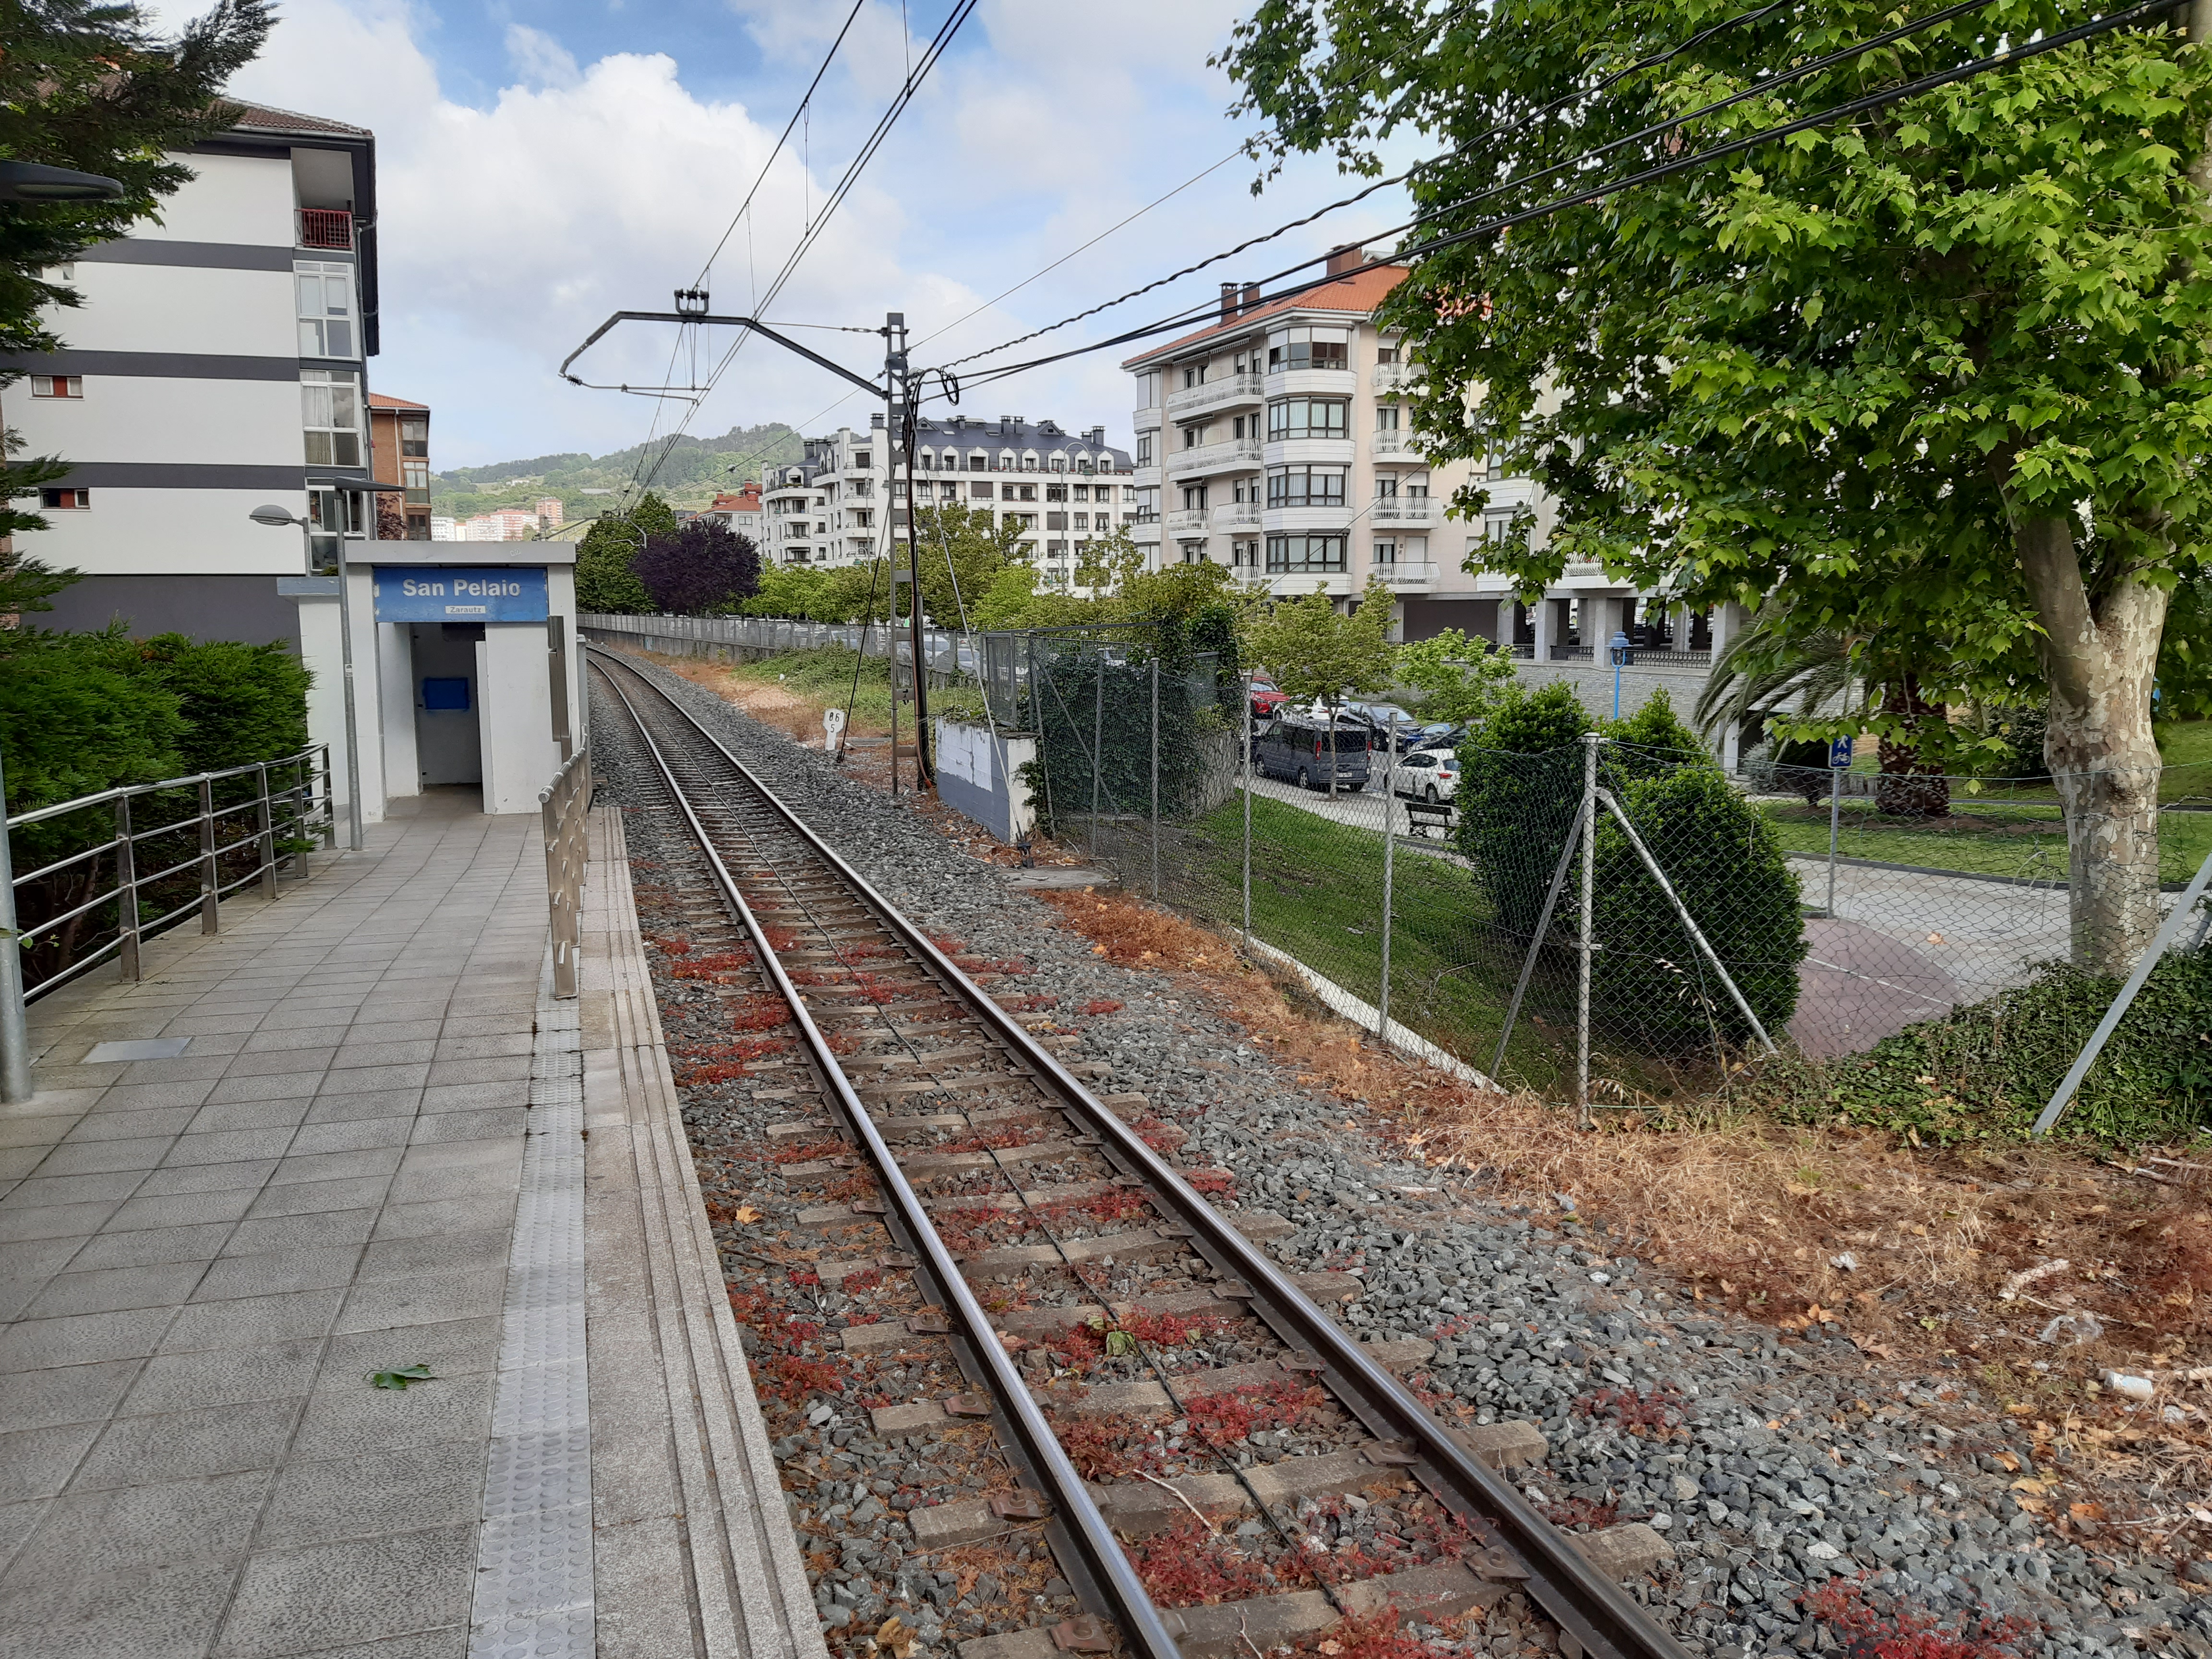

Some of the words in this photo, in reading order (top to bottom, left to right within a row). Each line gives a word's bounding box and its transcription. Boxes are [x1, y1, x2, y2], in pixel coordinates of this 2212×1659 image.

[403, 579, 445, 596] San
[454, 579, 521, 596] Pelaio
[830, 724, 835, 733] 5
